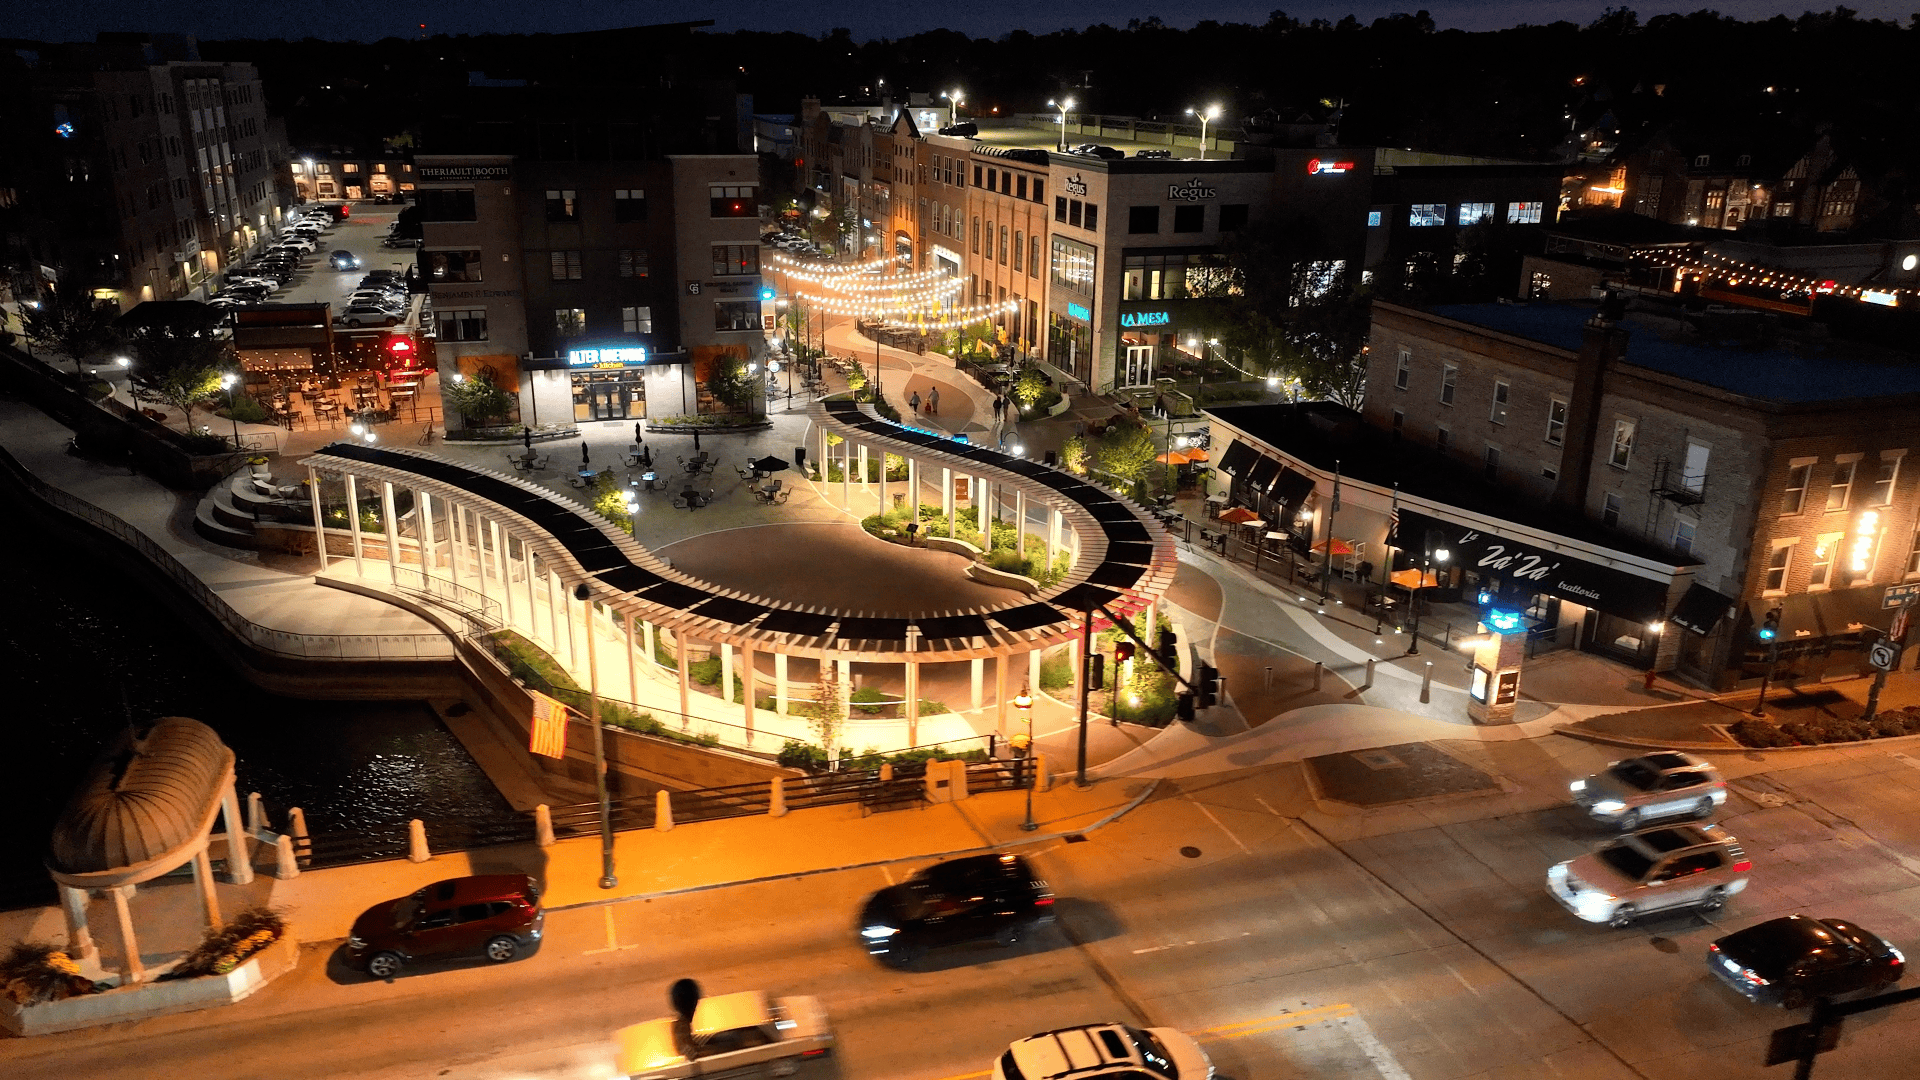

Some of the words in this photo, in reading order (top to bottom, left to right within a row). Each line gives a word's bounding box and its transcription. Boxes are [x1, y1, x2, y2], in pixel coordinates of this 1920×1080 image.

[1065, 178, 1085, 196] Regus
[1169, 185, 1216, 202] Regus
[1121, 313, 1135, 327] LA
[1136, 311, 1170, 326] MESA
[569, 350, 599, 365] ALTER
[1458, 530, 1479, 545] La
[1557, 580, 1601, 600] trattoria
